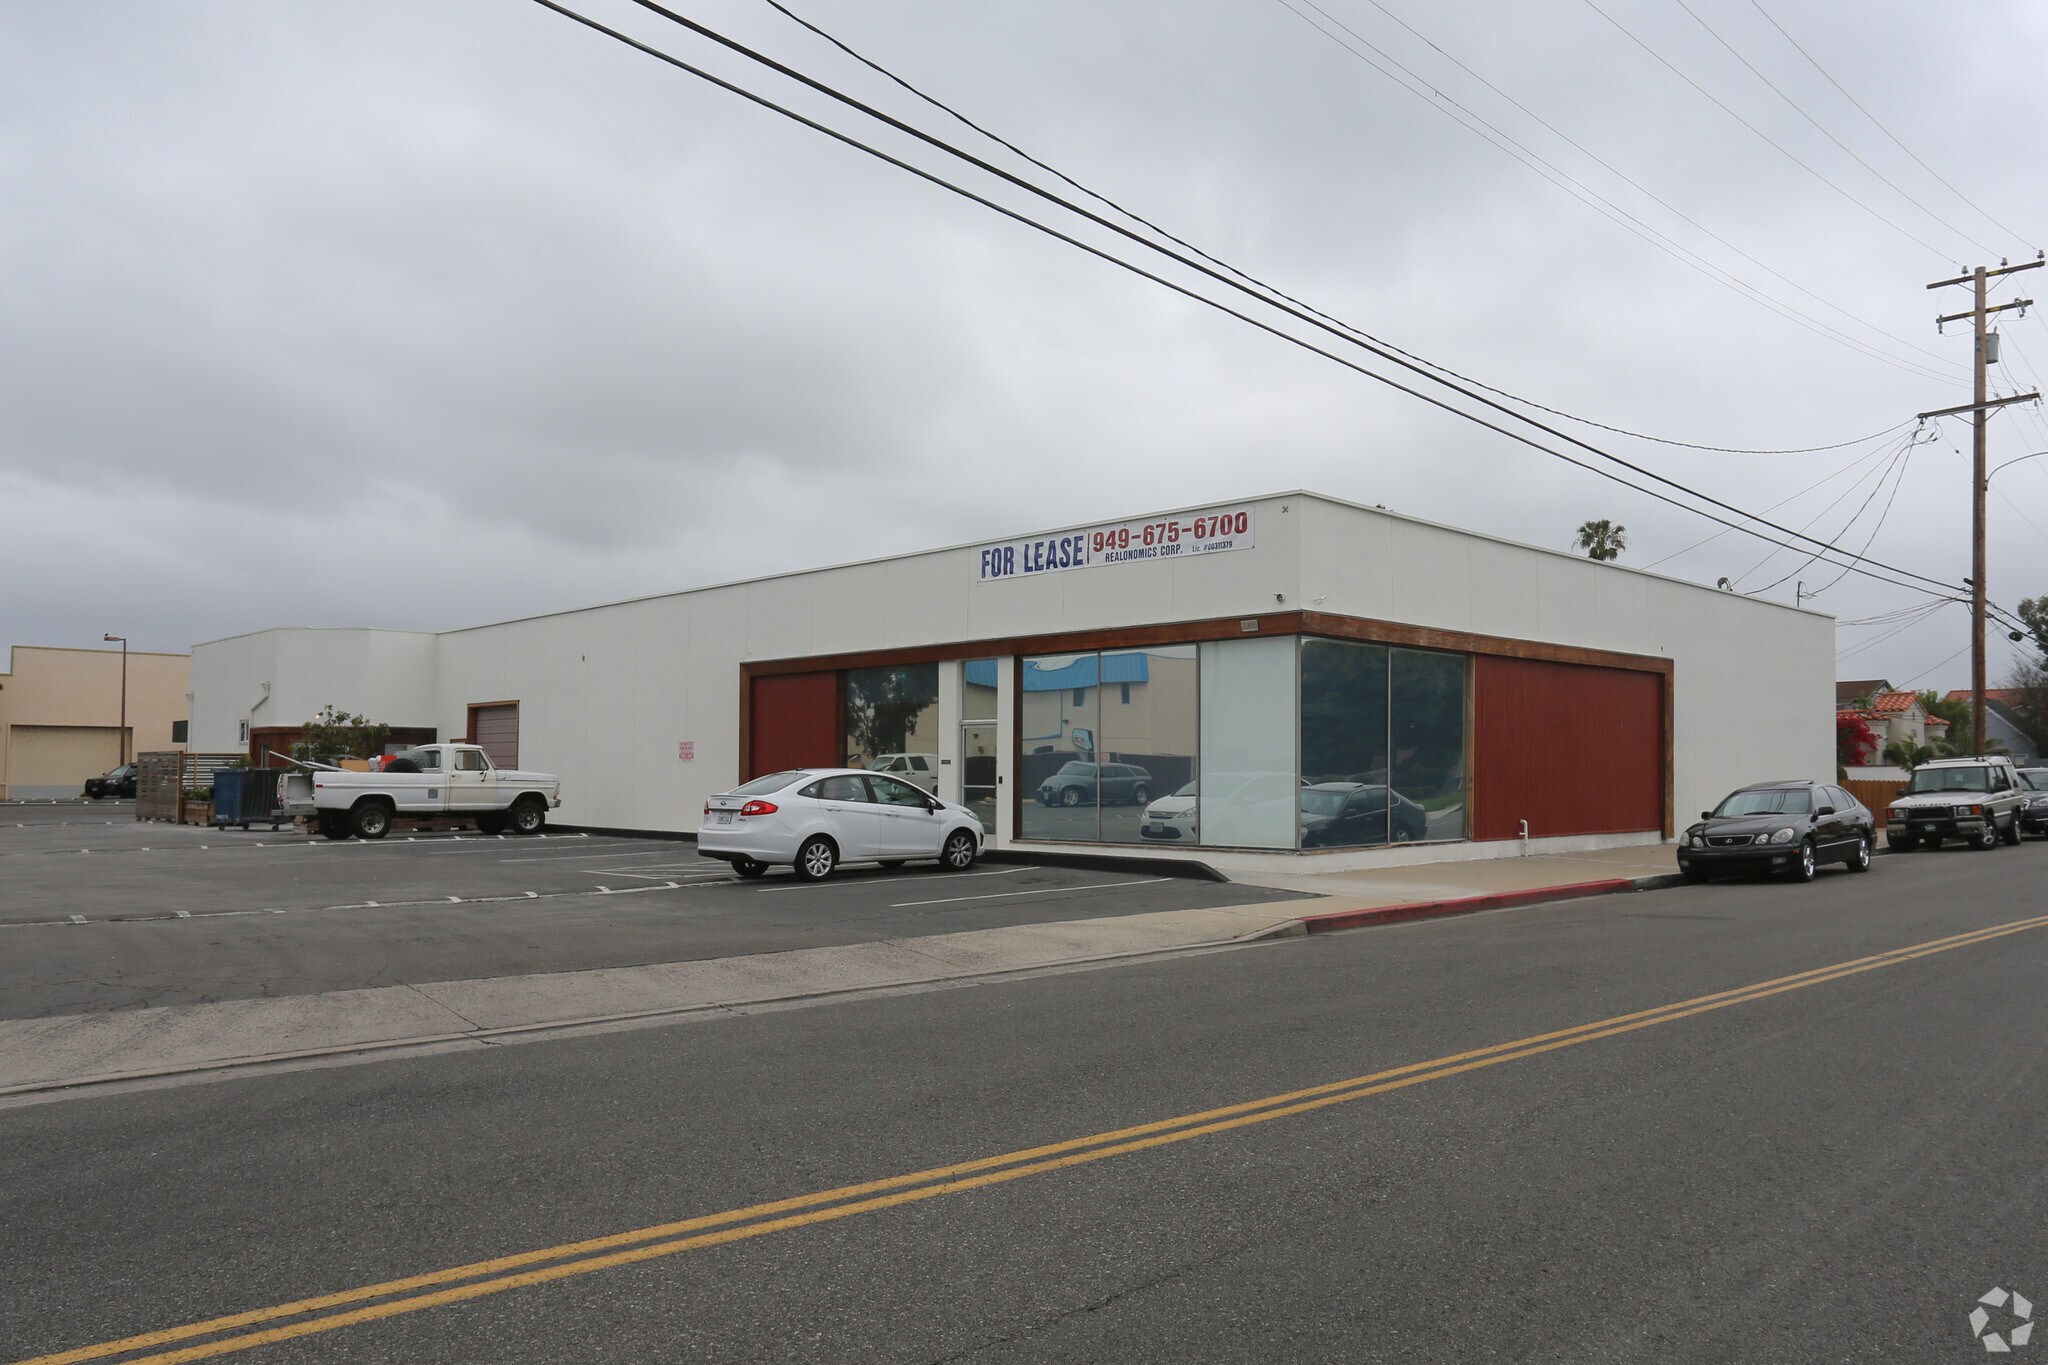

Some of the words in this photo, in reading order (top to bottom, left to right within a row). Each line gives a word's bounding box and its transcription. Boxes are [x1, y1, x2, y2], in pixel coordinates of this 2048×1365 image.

[1092, 511, 1249, 553] 949-675-6700
[981, 545, 1014, 579] FOR
[1024, 535, 1084, 573] LEASE
[1105, 547, 1157, 563] REALONOMICS
[1160, 544, 1183, 556] CORP.
